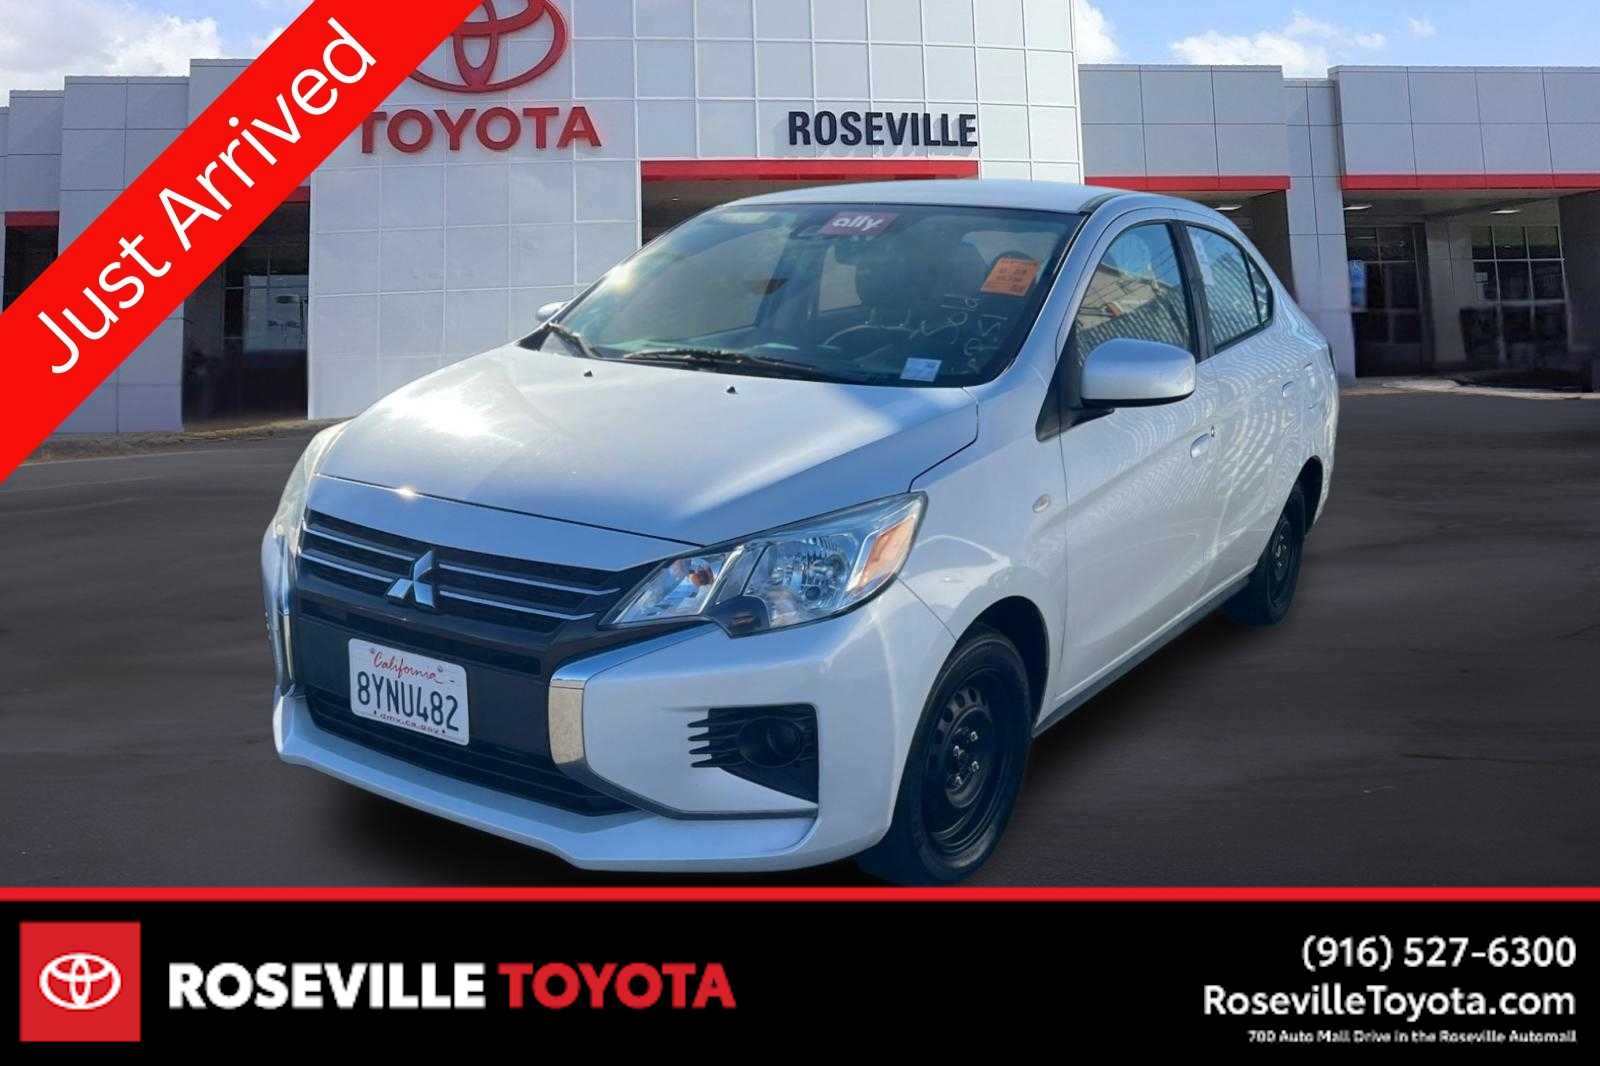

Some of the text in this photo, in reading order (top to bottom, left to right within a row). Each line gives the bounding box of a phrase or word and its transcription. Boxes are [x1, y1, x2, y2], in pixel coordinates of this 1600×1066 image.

[361, 106, 602, 154] TOYOTA
[788, 110, 978, 147] ROSEVILLE
[832, 216, 883, 232] ally
[373, 651, 443, 684] California
[357, 671, 459, 731] 8YNU482
